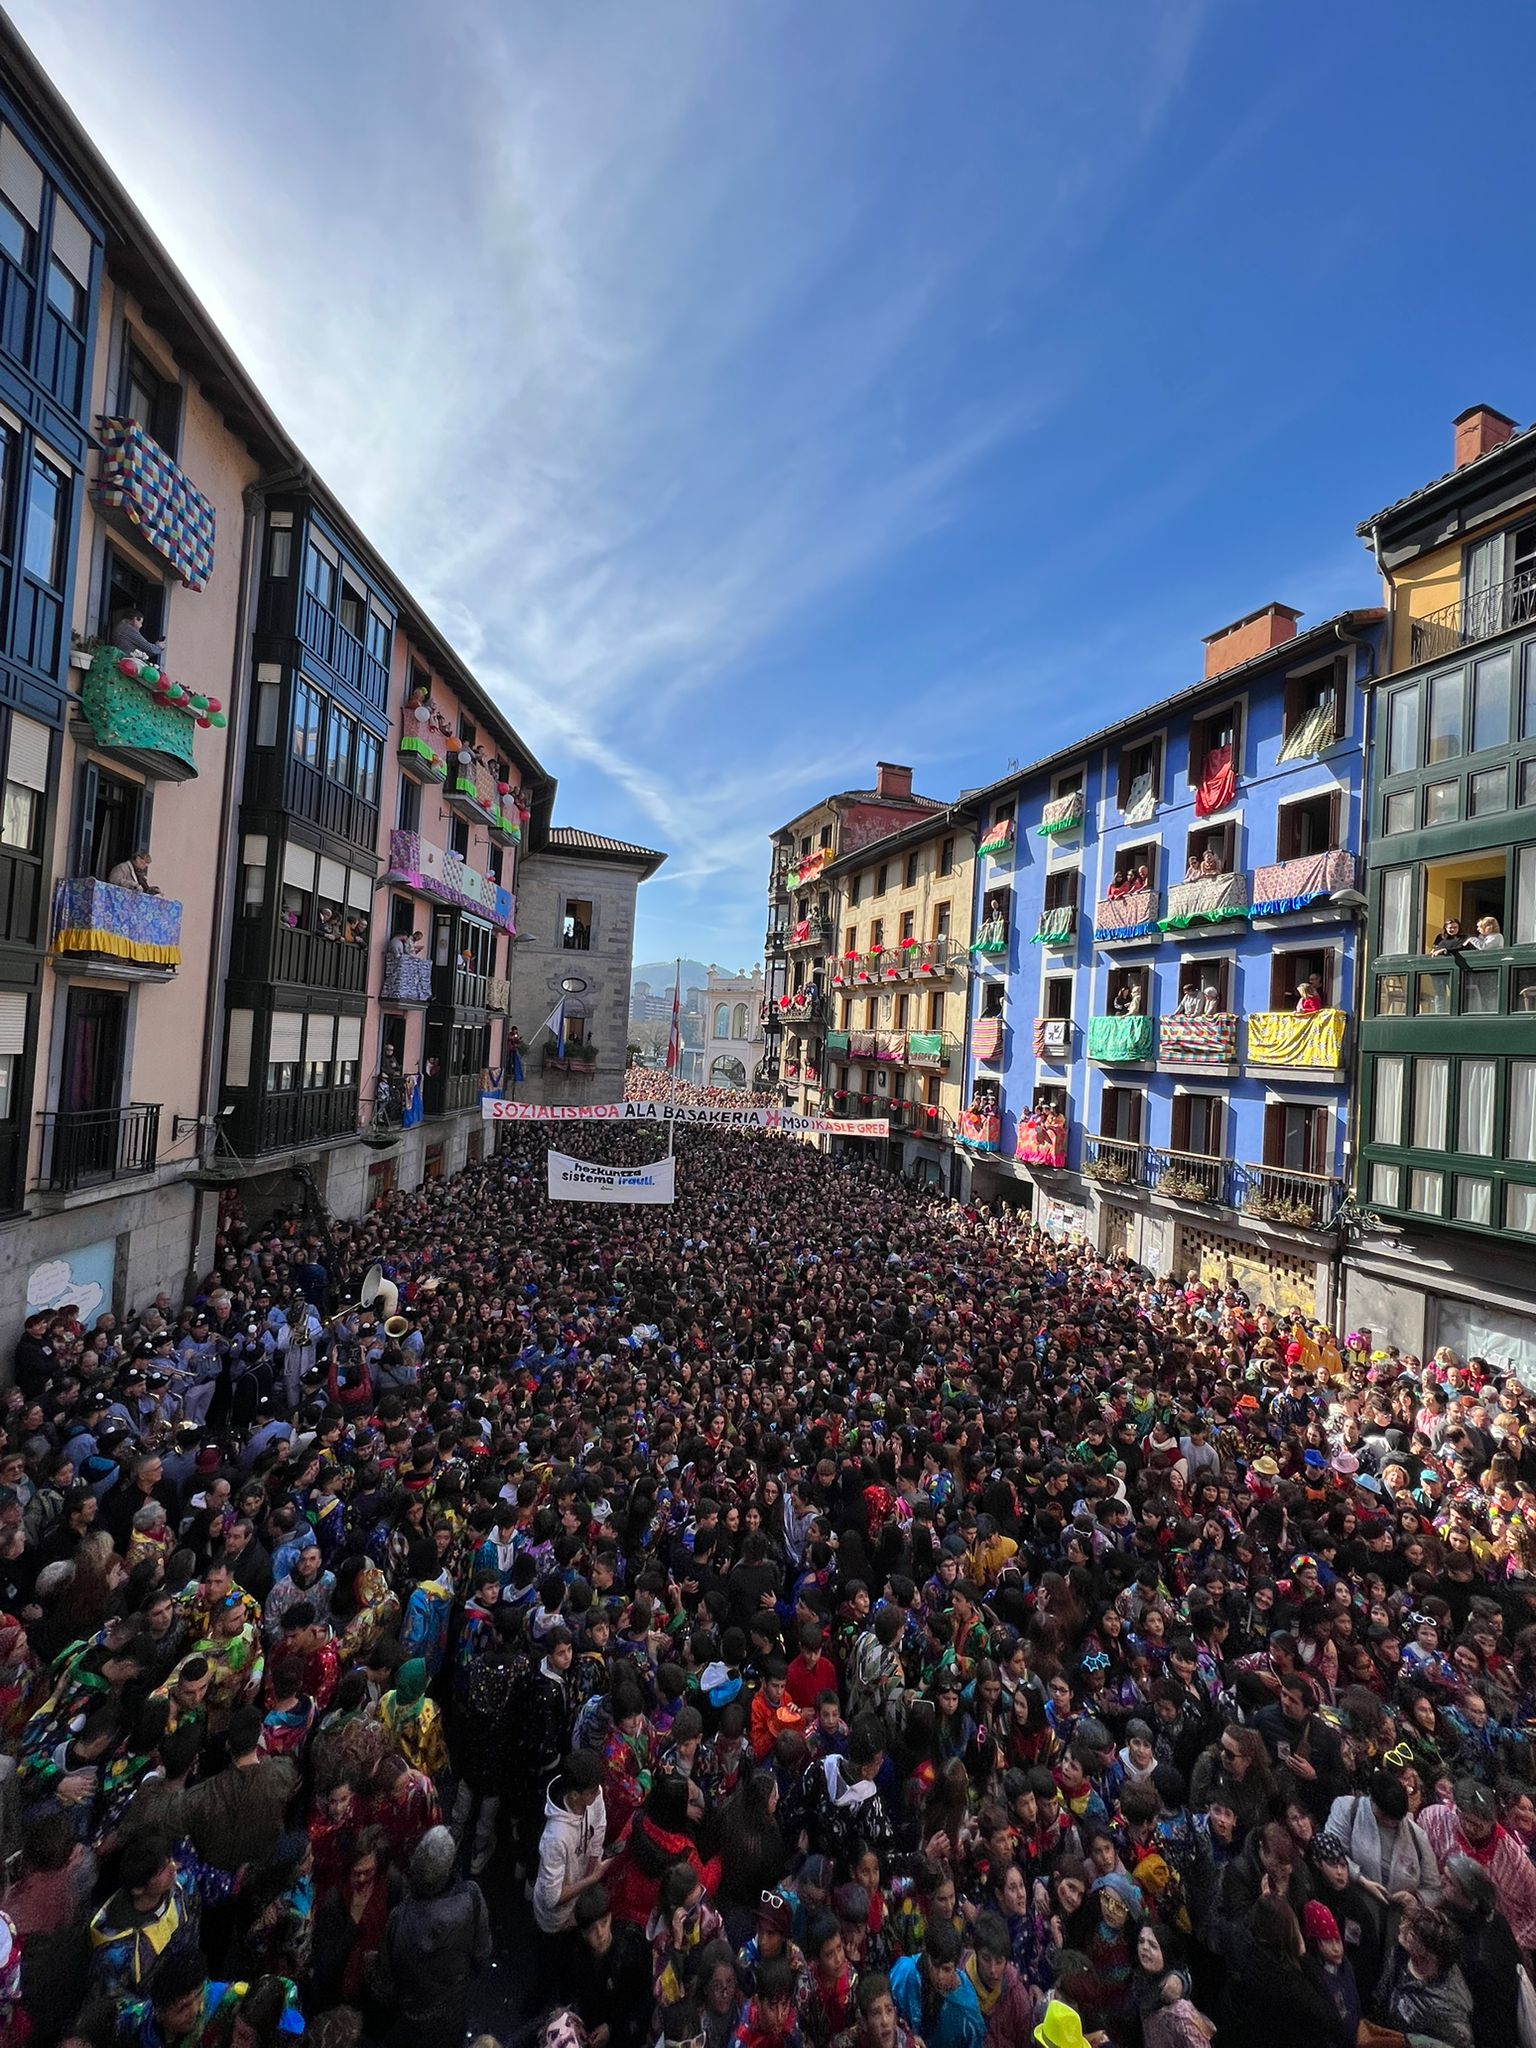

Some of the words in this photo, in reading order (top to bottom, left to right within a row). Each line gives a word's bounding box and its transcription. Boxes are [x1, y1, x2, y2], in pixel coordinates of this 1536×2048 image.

[492, 1102, 620, 1118] SOZIALISMOA
[624, 1103, 657, 1118] ALA
[663, 1106, 760, 1124] BASAKERIA
[811, 1120, 855, 1133] IKASLE
[574, 1163, 642, 1177] hezkuntza
[561, 1171, 614, 1185] sistema
